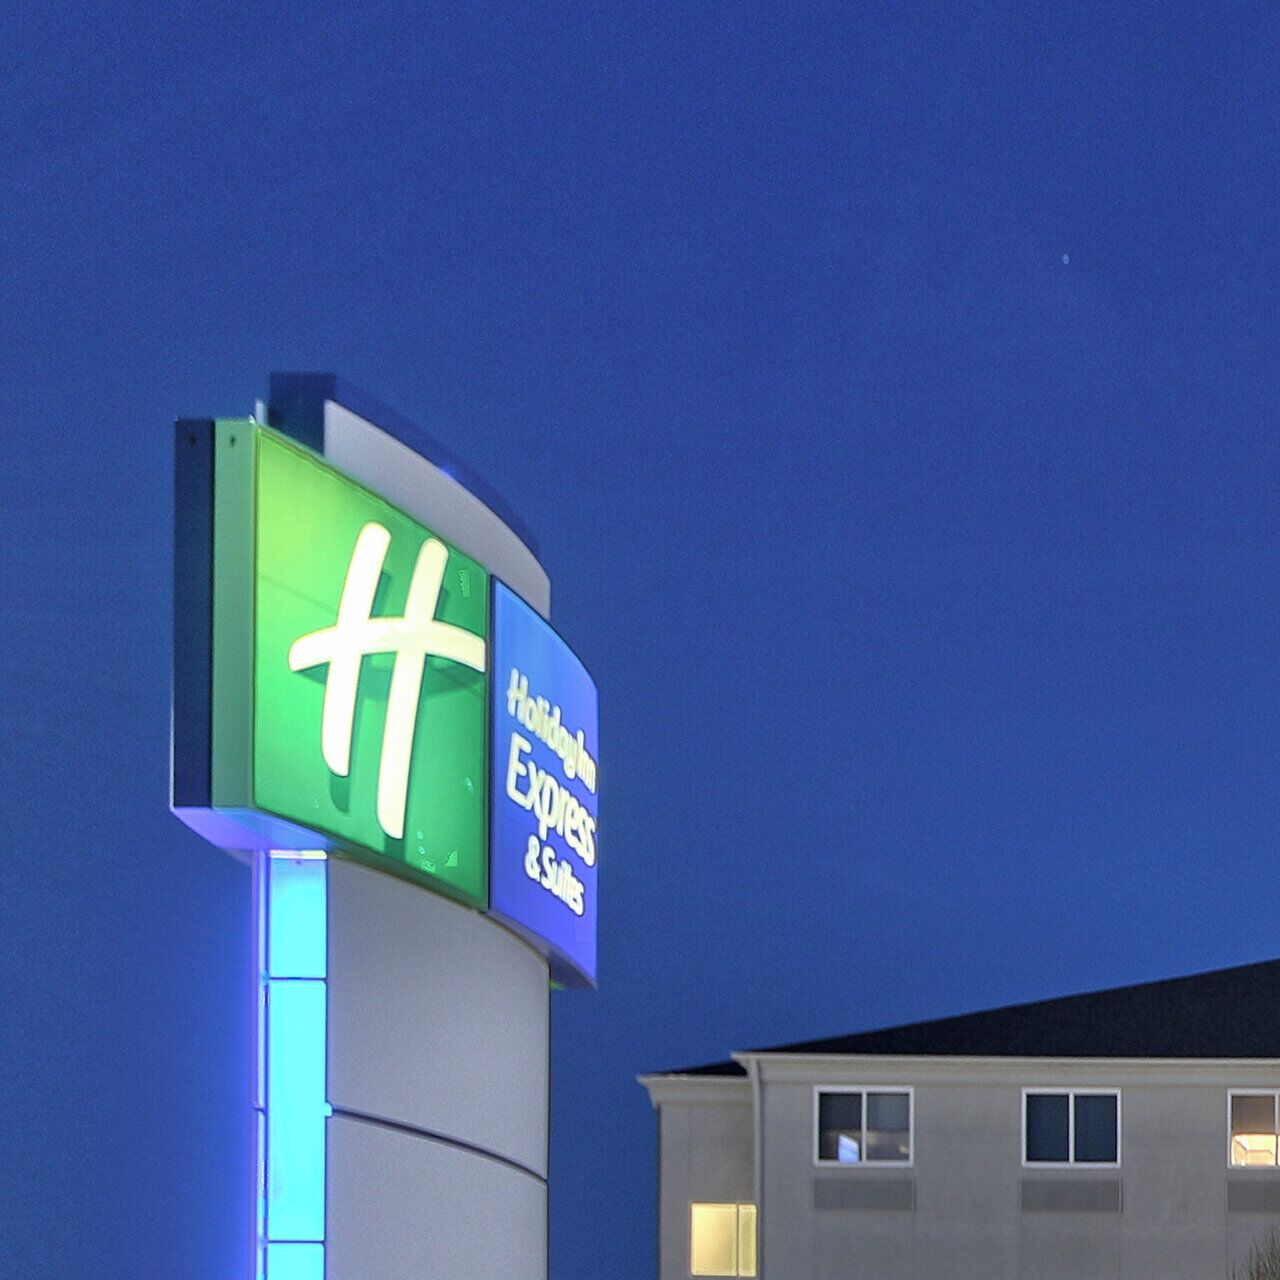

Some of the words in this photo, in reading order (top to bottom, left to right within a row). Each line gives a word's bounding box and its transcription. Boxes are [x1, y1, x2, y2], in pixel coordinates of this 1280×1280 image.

[507, 667, 577, 779] Holiday
[506, 731, 597, 867] Express
[525, 834, 542, 882] &
[540, 846, 585, 916] Suites
